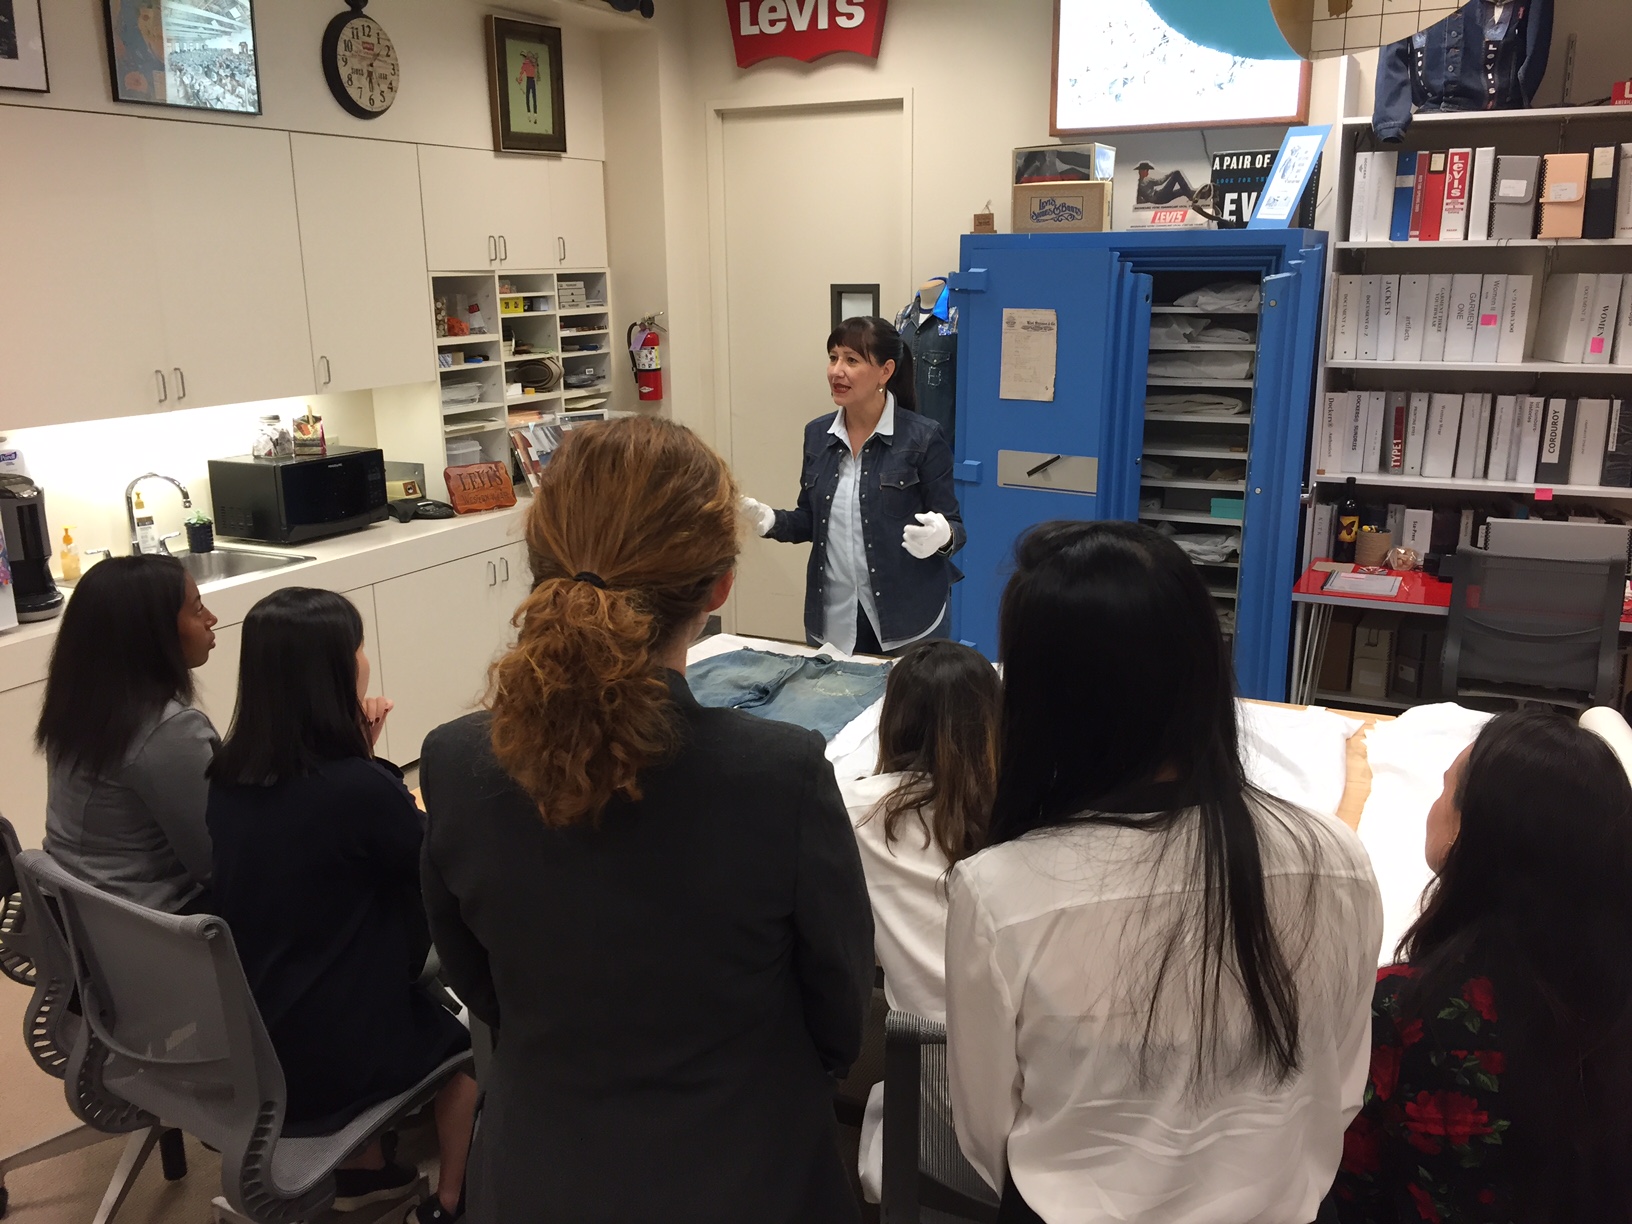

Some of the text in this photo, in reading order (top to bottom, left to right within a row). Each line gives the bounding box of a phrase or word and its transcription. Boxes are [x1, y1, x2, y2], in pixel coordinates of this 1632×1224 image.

[351, 26, 360, 40] 11
[361, 24, 372, 38] 12
[343, 39, 353, 53] 10
[385, 44, 391, 58] 2
[342, 54, 348, 67] 9
[390, 63, 396, 76] 3
[346, 74, 354, 86] 8
[387, 80, 394, 92] 4
[357, 86, 363, 100] 7
[380, 90, 386, 104] 5
[368, 94, 375, 107] 6
[1212, 154, 1272, 170] A PAIR OF
[1490, 280, 1500, 306] Women
[1582, 286, 1590, 315] DOCUMENT
[1456, 303, 1465, 320] ONE
[1466, 293, 1476, 330] GARMENT
[1548, 410, 1560, 454] CORDUROY
[457, 466, 503, 491] LEVI'S
